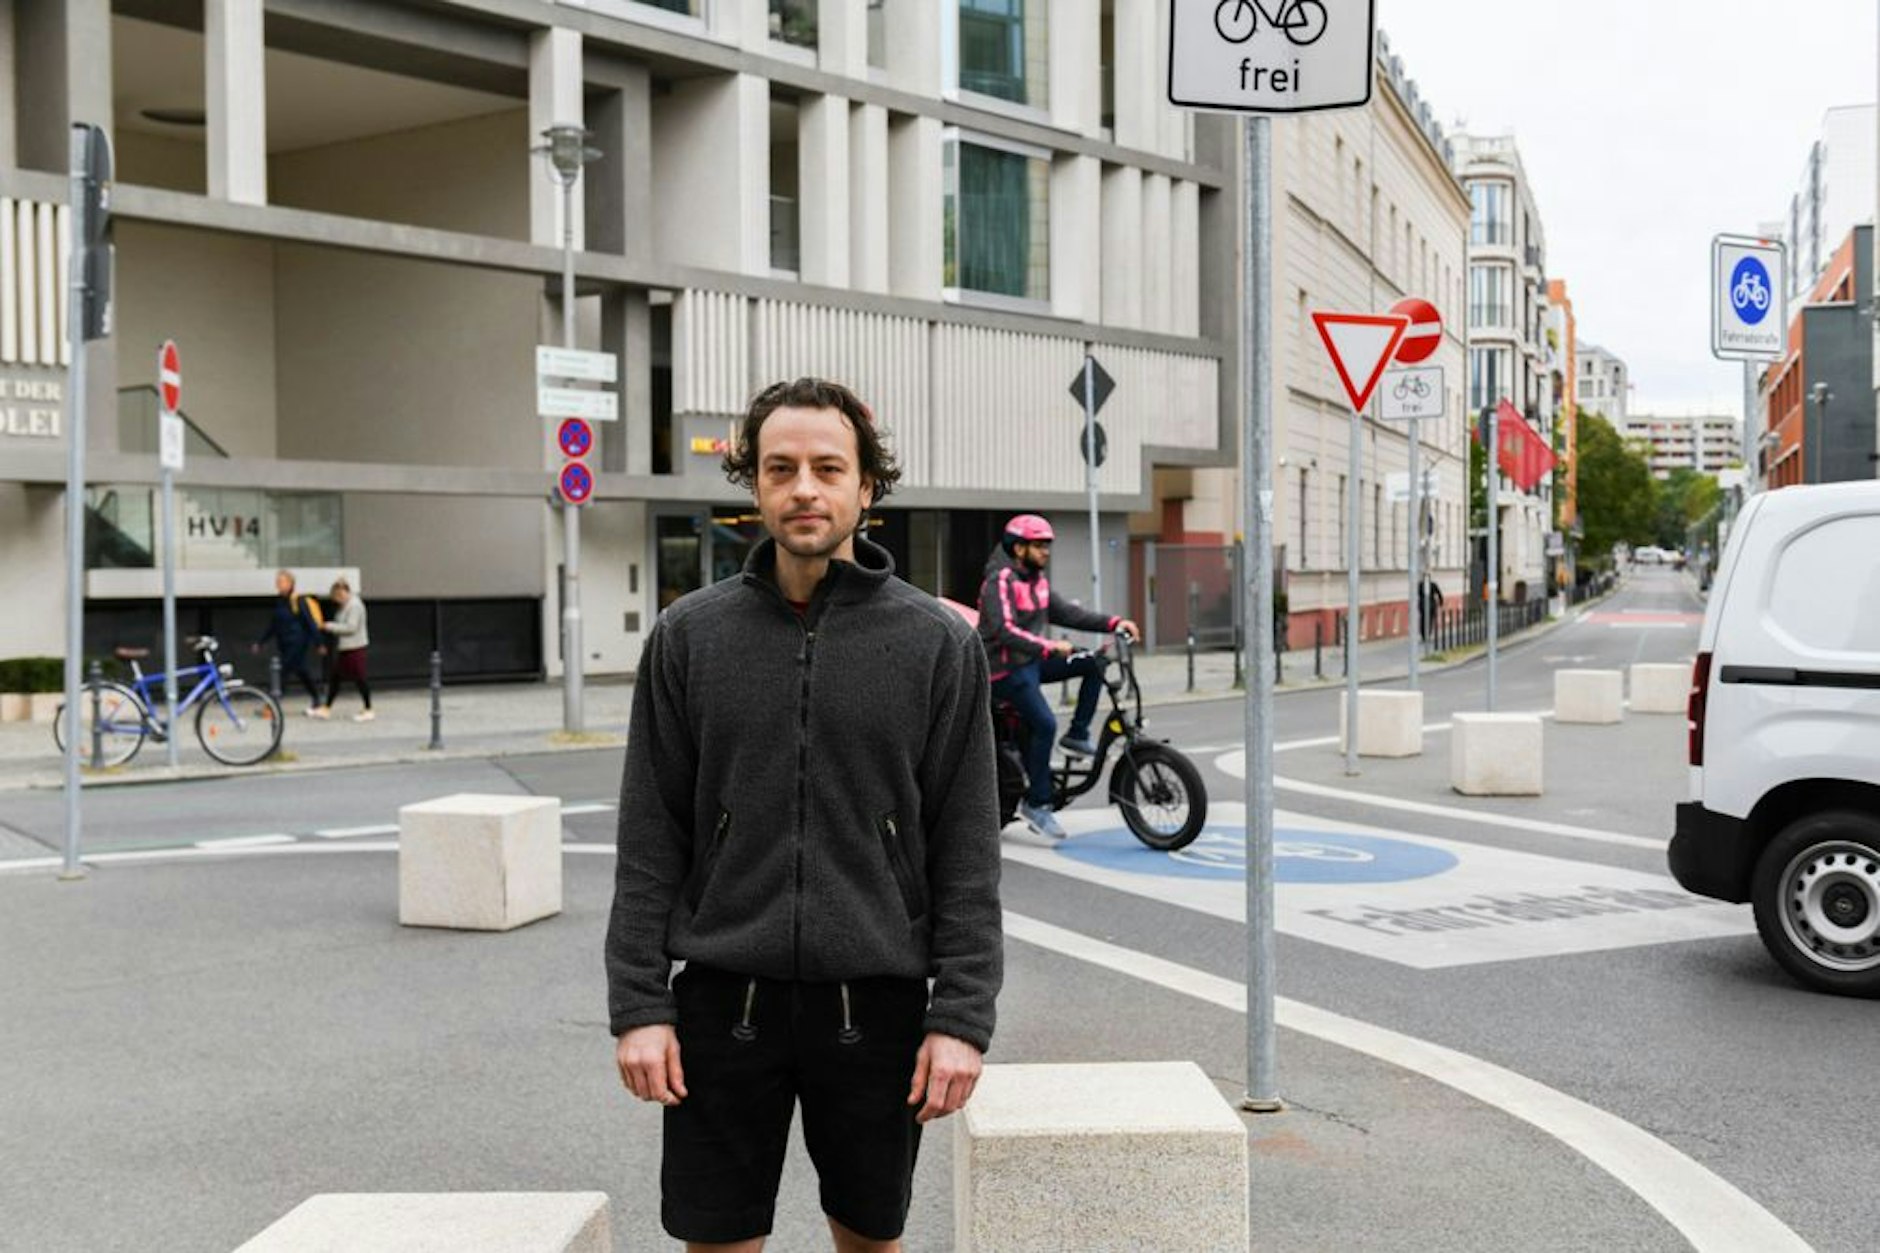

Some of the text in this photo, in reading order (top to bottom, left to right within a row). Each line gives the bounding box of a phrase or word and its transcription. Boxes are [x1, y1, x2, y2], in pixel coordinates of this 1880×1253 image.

[1239, 58, 1300, 92] frei
[15, 380, 61, 401] DER
[0, 408, 61, 436] LEI
